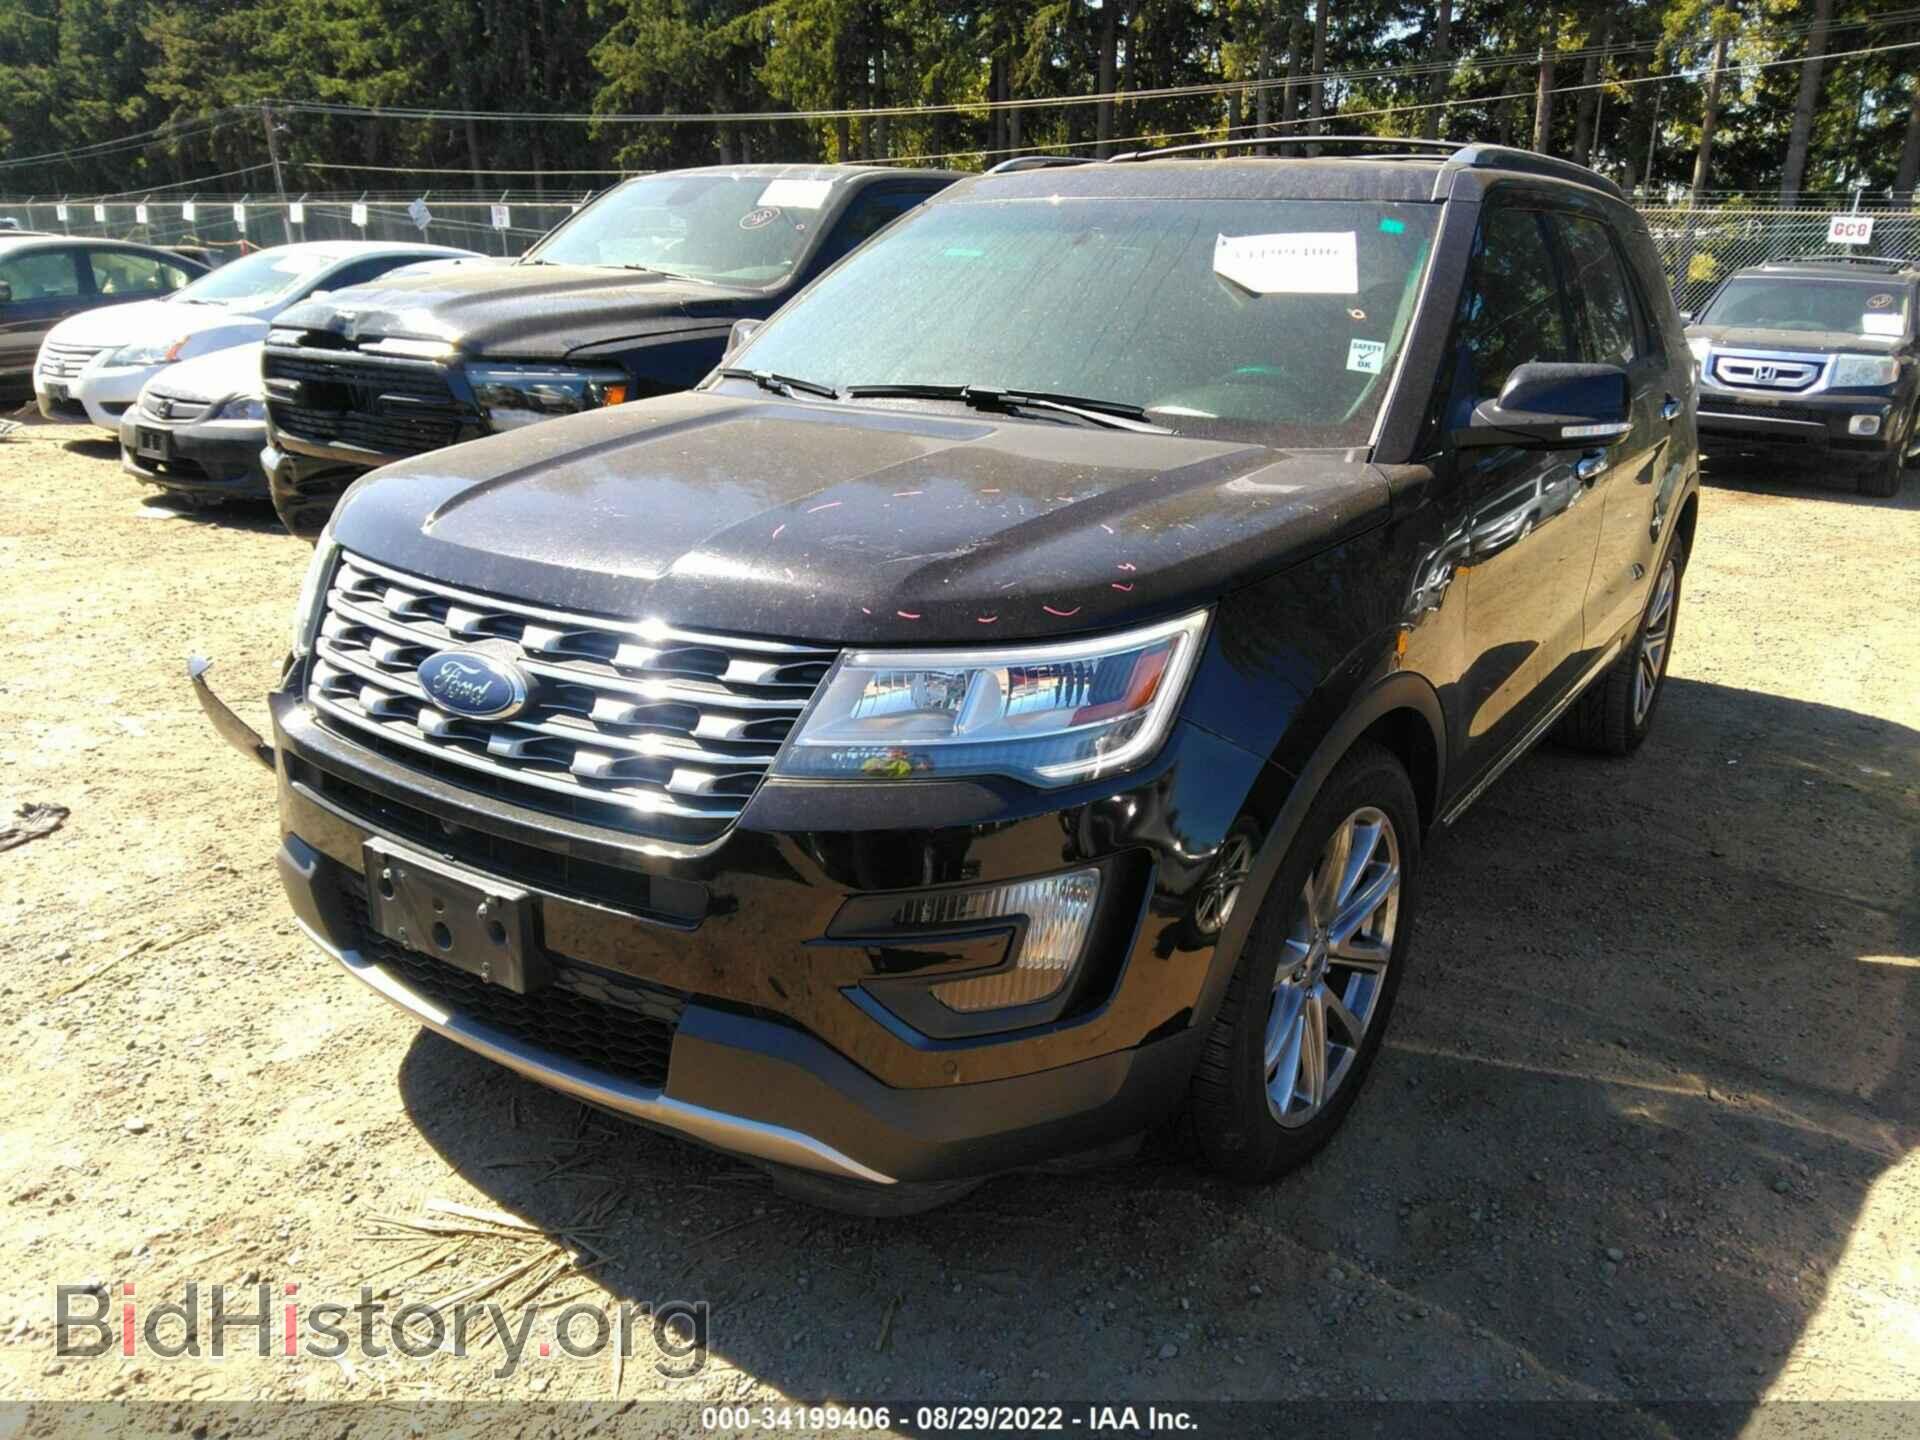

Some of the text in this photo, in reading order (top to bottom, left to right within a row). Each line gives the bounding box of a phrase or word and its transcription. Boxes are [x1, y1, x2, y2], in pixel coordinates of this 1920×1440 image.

[1352, 342, 1382, 352] SAFETY
[1357, 361, 1372, 369] OK
[432, 660, 493, 706] Ford
